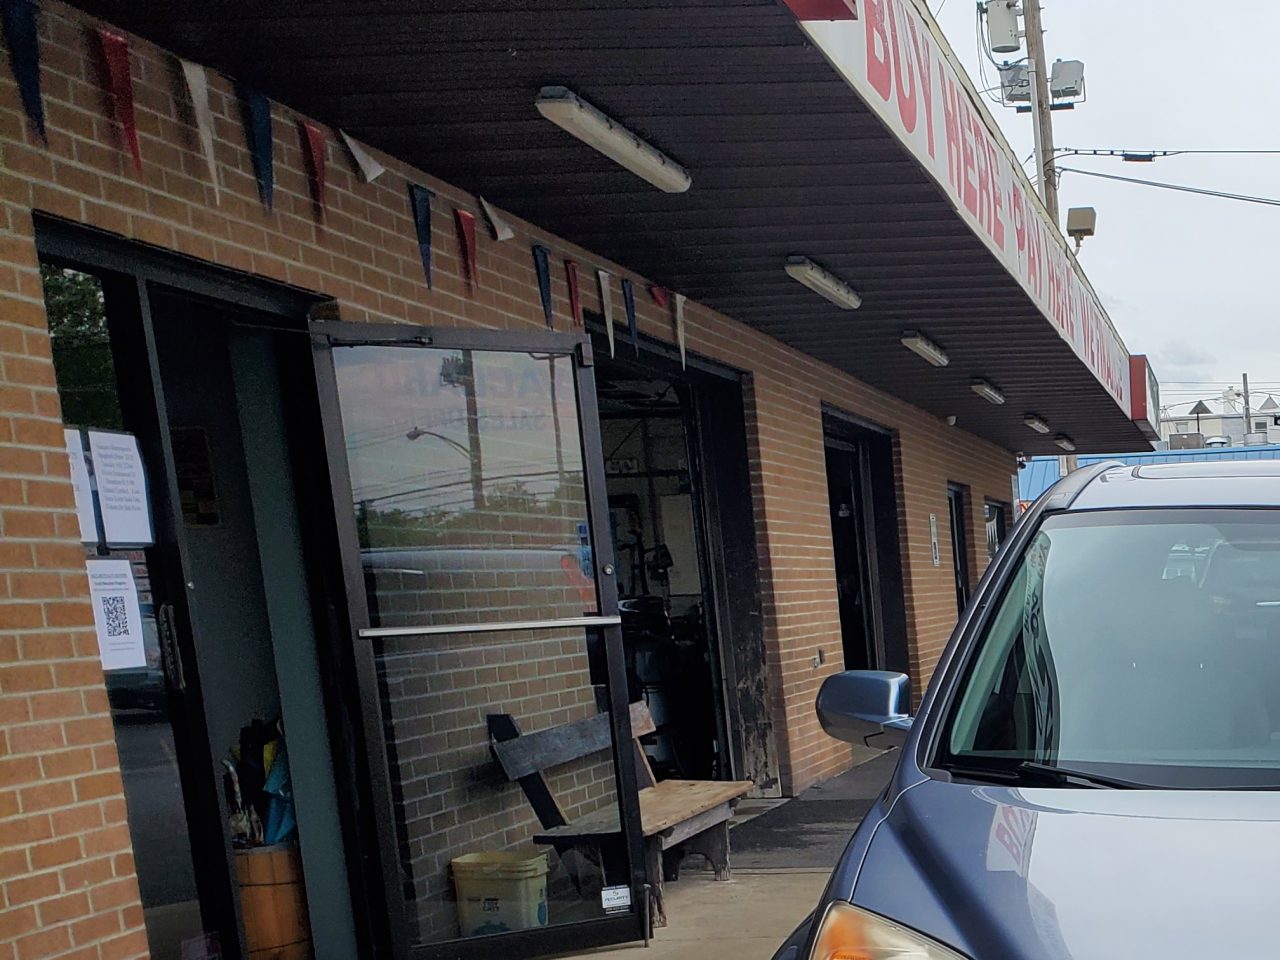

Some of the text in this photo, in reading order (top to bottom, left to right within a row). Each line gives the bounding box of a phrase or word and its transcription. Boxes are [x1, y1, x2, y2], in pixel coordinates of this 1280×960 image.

[864, 0, 935, 161] BUY
[938, 57, 1005, 253] HERE
[1012, 180, 1042, 301] PAY
